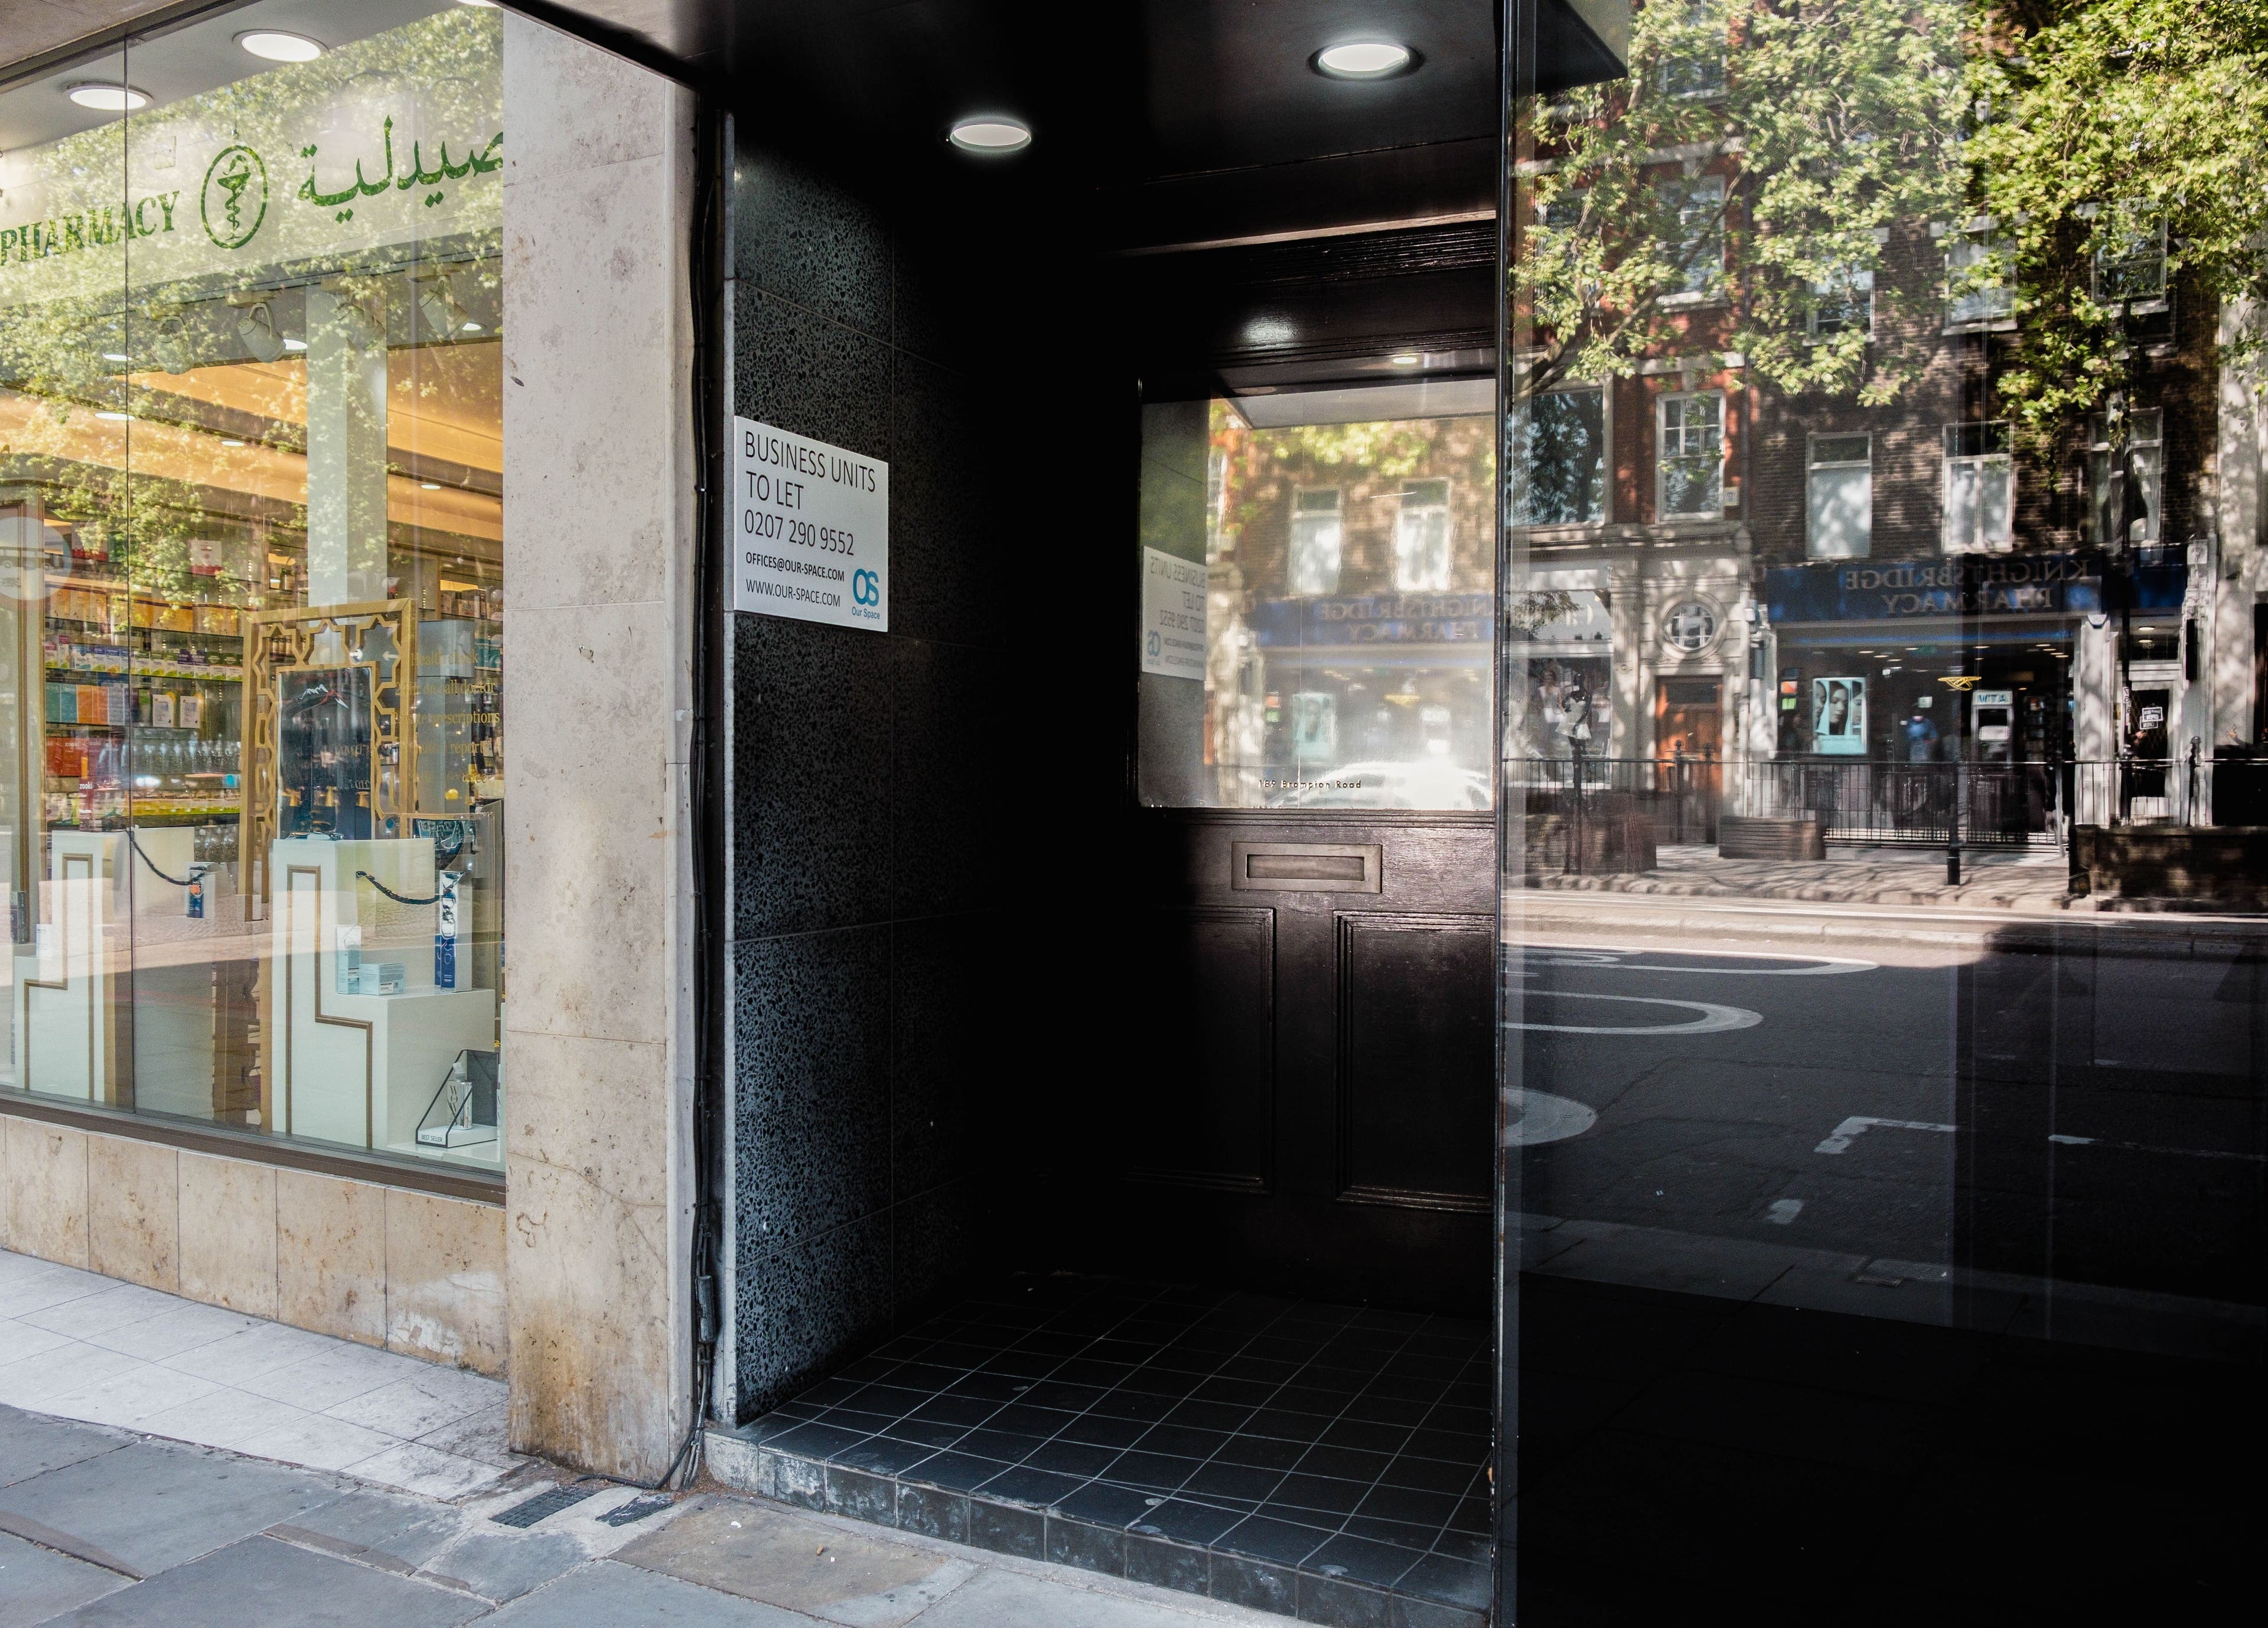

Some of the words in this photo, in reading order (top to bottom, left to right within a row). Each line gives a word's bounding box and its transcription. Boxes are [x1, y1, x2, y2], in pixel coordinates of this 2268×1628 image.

[0, 190, 180, 265] PHARMACY
[746, 431, 825, 478] BUSINESS
[831, 456, 875, 493] UNITS
[746, 470, 770, 501] TO
[777, 478, 804, 510] LET
[745, 509, 784, 540] 0207
[789, 519, 816, 547] 290
[820, 527, 854, 556] 9552
[746, 552, 845, 582] OFFICES@OUR-SPACE.COM
[746, 578, 840, 607] WWW.OUR-SPACE.COM
[853, 568, 879, 607] OS
[852, 606, 862, 616] Our
[863, 608, 880, 620] Space
[439, 679, 457, 695] call
[460, 678, 496, 694] doctor
[430, 709, 500, 727] prescriptions
[79, 782, 93, 790] zooki
[1259, 780, 1276, 789] 189
[1281, 780, 1330, 791] Brompton
[1336, 780, 1361, 789] Road
